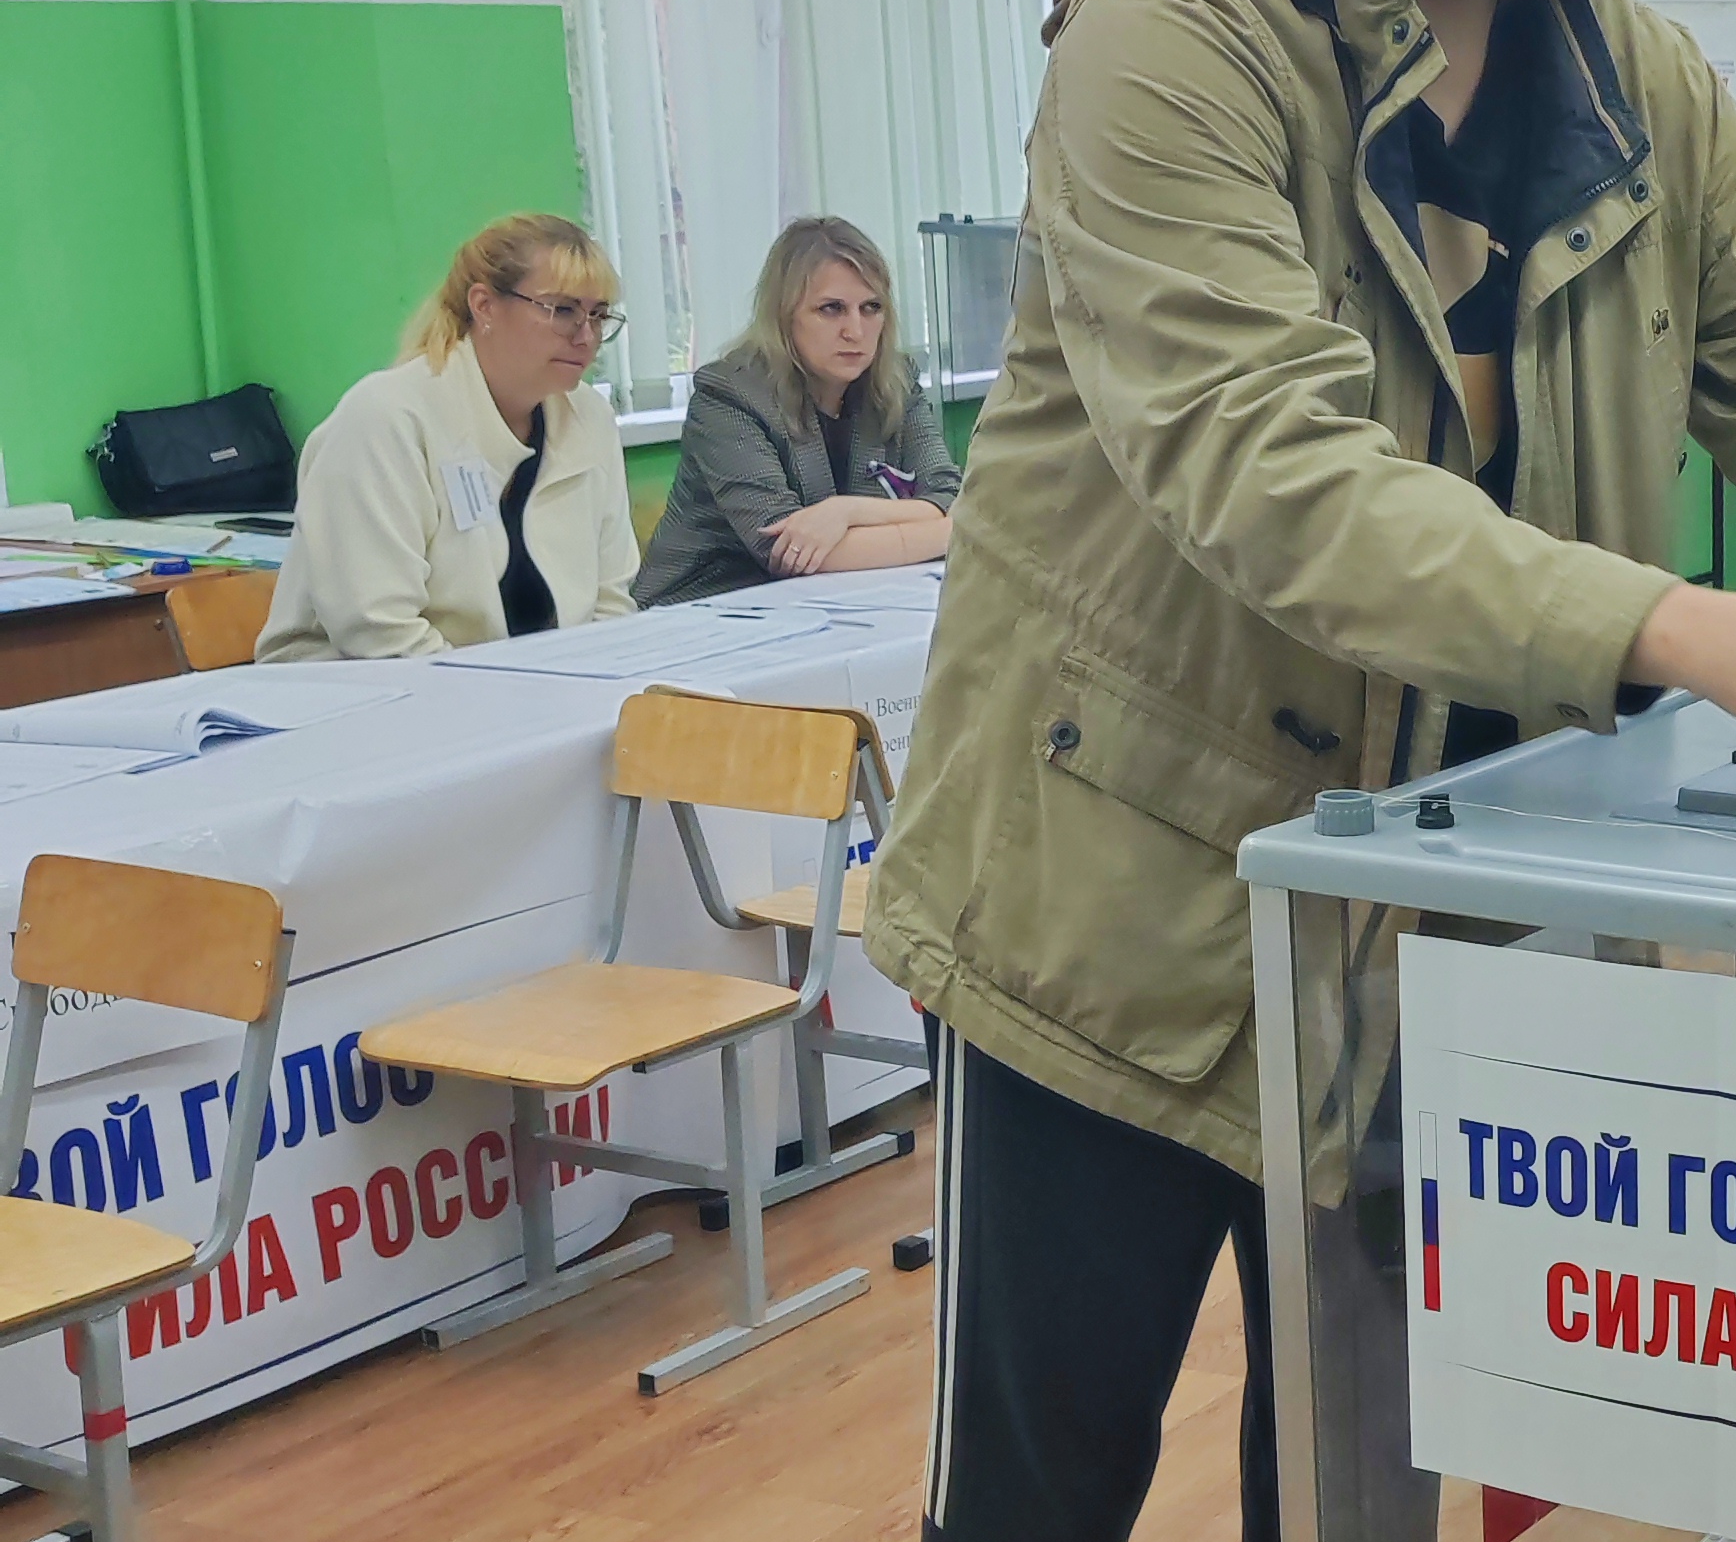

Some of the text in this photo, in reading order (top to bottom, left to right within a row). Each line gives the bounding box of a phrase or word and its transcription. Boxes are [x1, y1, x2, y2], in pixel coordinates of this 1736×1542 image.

[63, 1084, 609, 1376] ИЛА РОССИ!
[1459, 1118, 1639, 1228] ТВОЙ
